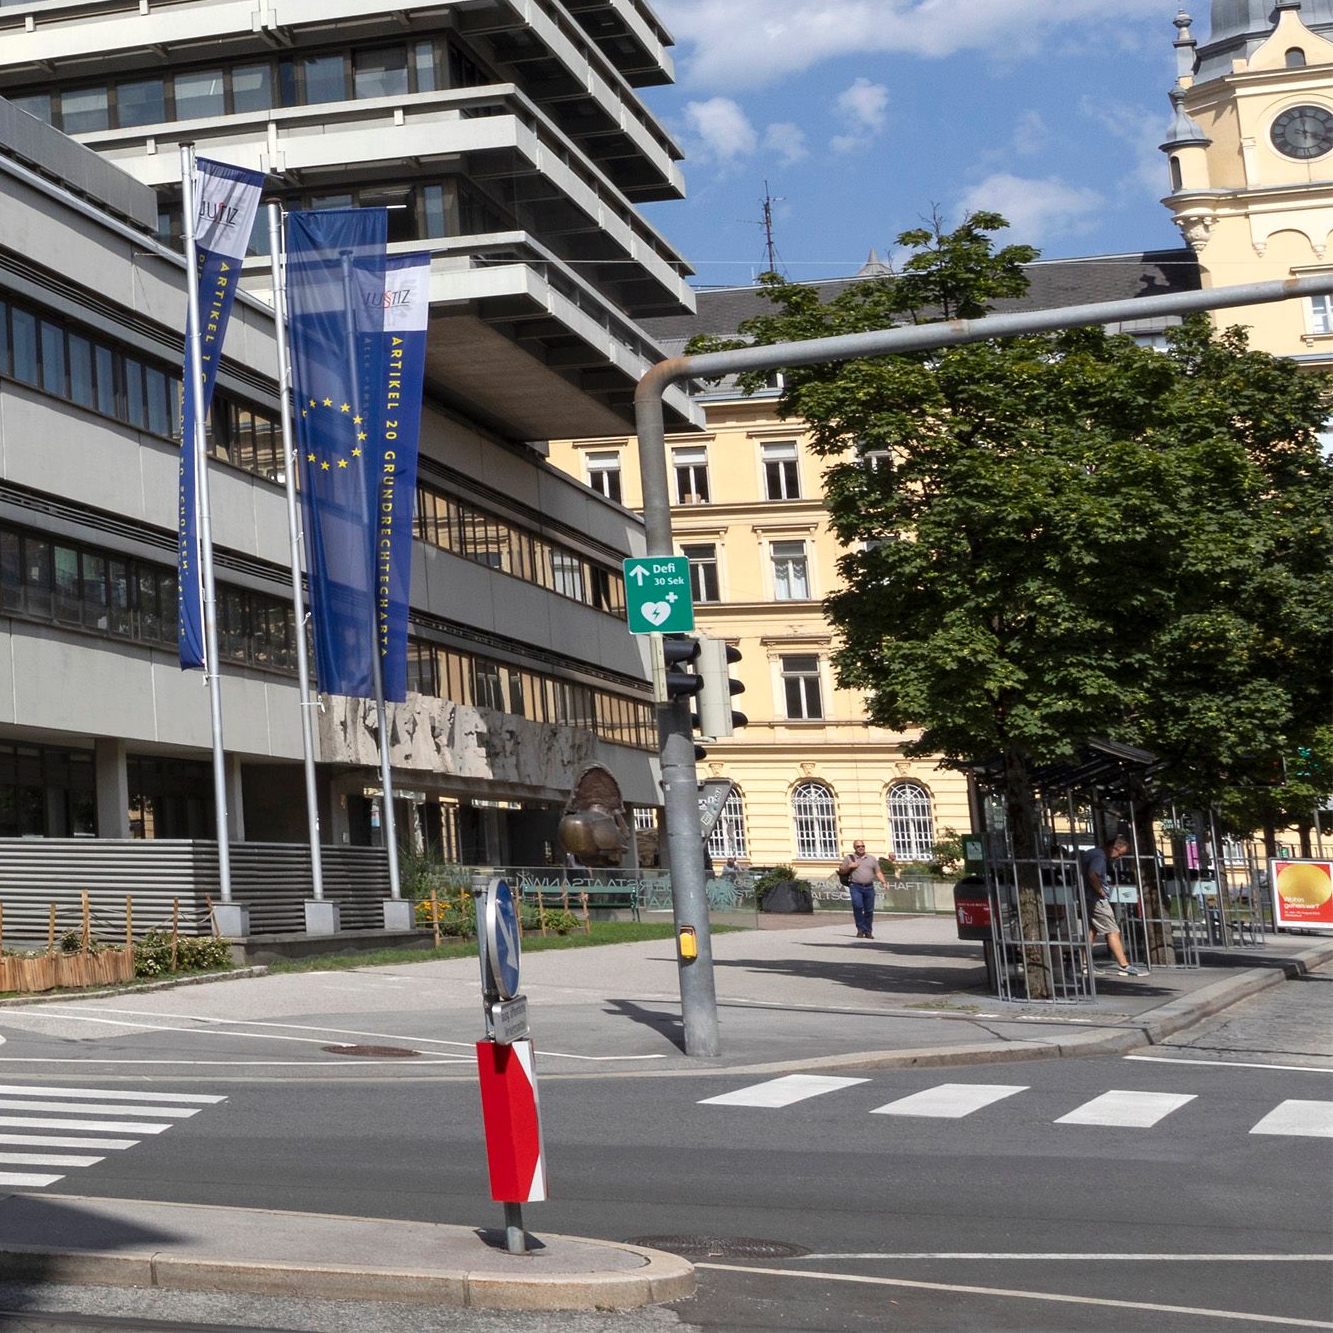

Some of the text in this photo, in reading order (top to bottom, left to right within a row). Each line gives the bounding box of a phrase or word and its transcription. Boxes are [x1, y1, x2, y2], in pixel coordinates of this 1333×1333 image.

[205, 262, 230, 343] ARTIKEL
[379, 337, 403, 657] ARTIKEL 20 GRUNDRECHTECHARTA
[653, 563, 676, 574] Defi
[654, 576, 685, 586] 30 Sek
